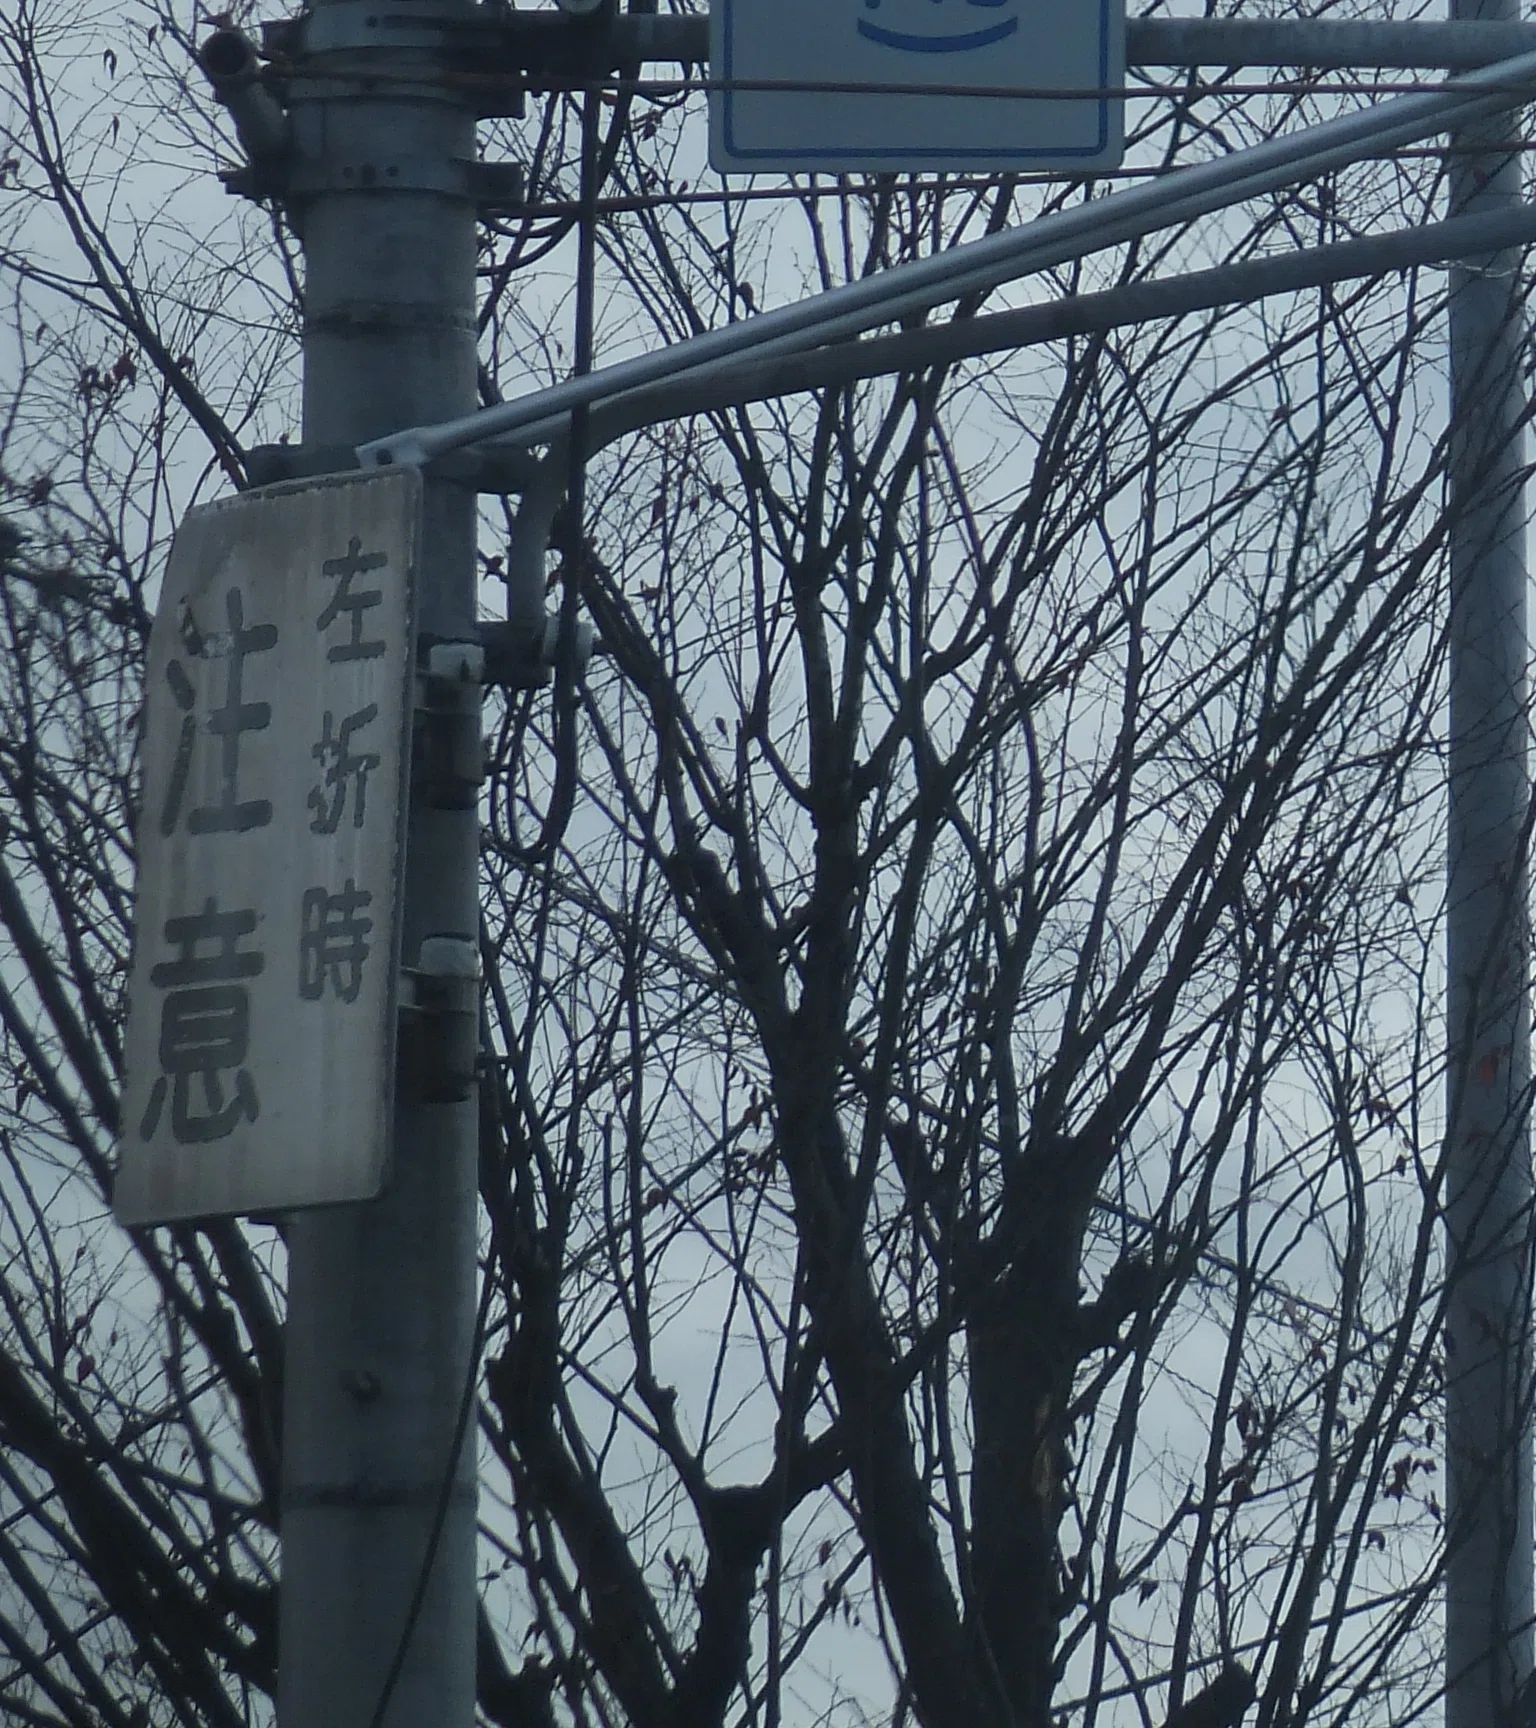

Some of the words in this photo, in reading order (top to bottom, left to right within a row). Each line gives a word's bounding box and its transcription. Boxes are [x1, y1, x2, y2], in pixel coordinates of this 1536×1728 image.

[140, 585, 279, 1144] 注意
[298, 535, 389, 1005] 左折時
